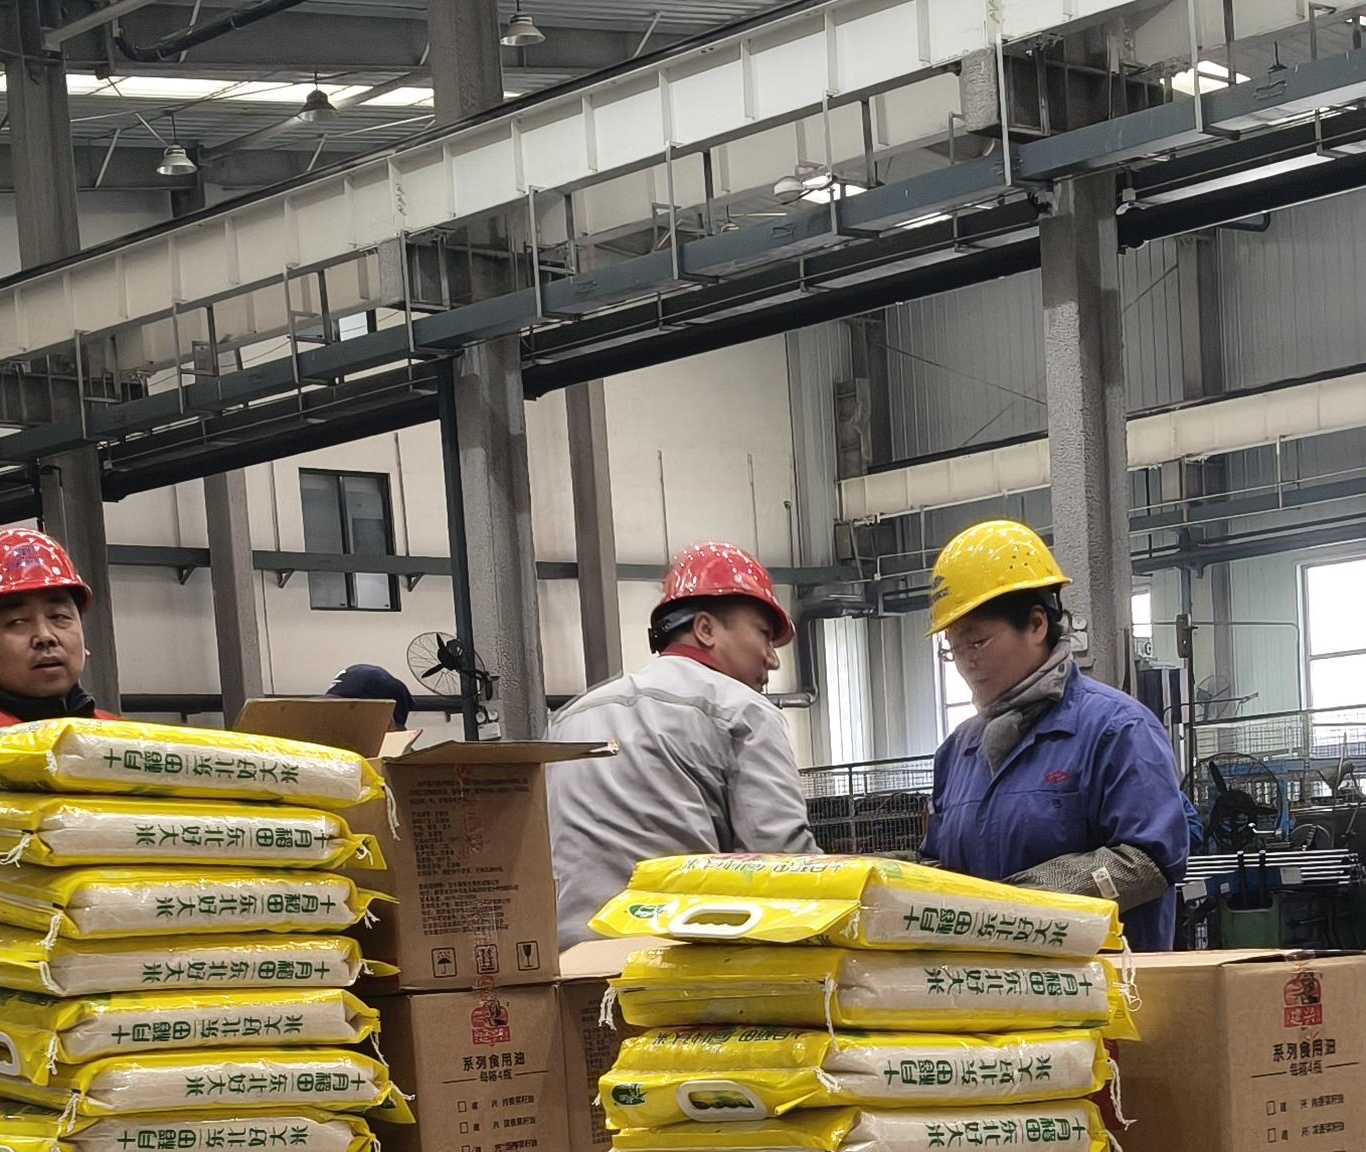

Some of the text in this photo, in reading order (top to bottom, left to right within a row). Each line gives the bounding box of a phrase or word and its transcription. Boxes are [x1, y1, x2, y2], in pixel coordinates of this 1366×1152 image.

[104, 749, 299, 784] 十月稻田 东北好大米
[135, 826, 331, 849] 十月稻田 东北好大米
[156, 893, 336, 917] 十月稻田 东北好大米
[903, 907, 1068, 946] 十月稻田 东北好大米
[142, 960, 330, 982] 十月稻田 东北好大米
[925, 968, 1092, 996] 十月稻田 东北好大米
[113, 1016, 303, 1043] 十月稻田 东北好大米
[463, 1052, 525, 1072] 系列食用油
[1273, 1039, 1336, 1062] 系列食用油
[186, 1072, 365, 1095] 十月稻田 东北好大米
[884, 1057, 1051, 1086] 十月稻田 东北好大米
[117, 1126, 308, 1150] 十月稻田 东北好大米
[927, 1117, 1085, 1147] 十月稻田 东北好大米
